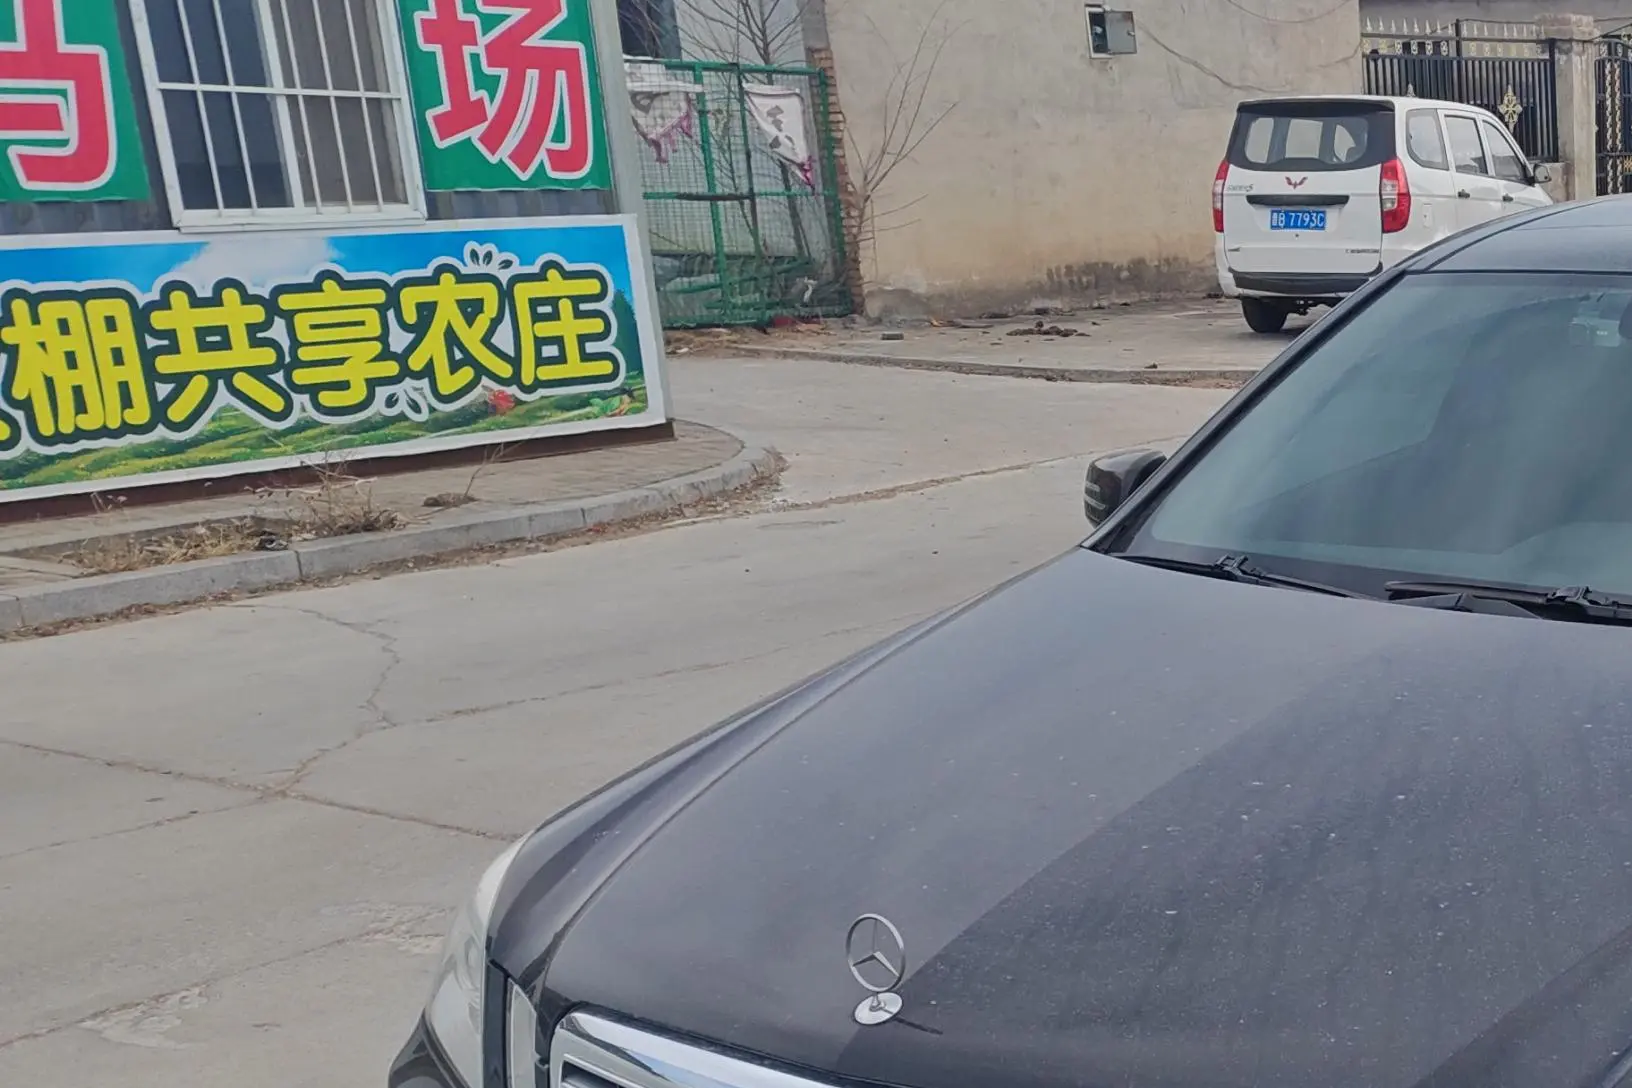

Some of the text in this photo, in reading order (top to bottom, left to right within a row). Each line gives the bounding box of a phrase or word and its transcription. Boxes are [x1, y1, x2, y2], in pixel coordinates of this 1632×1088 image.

[0, 267, 614, 441] 棚共享农庄
